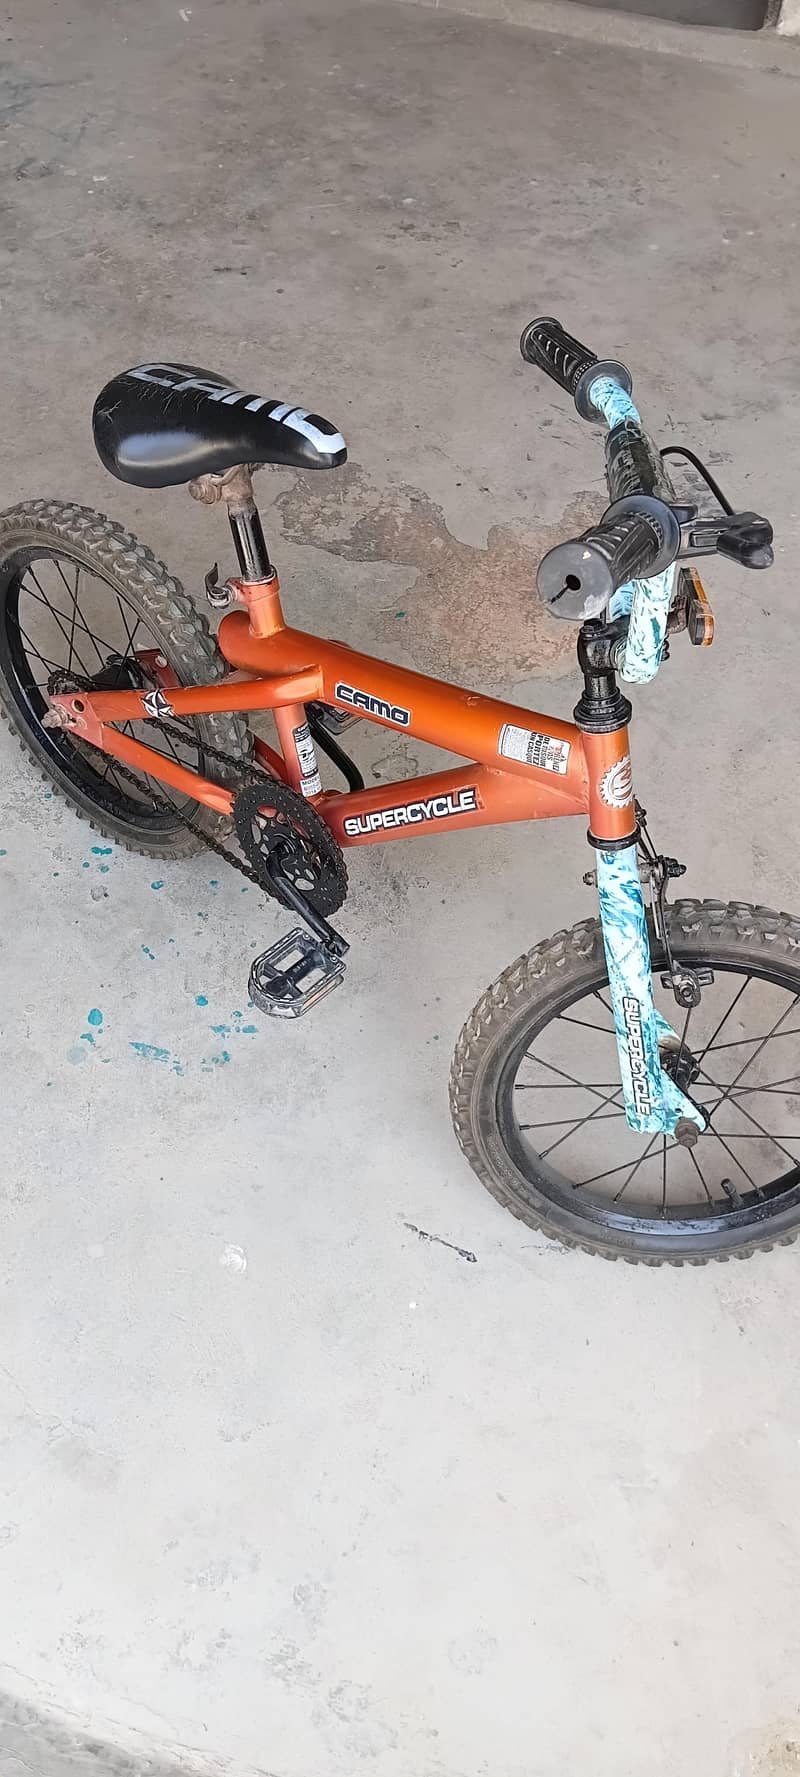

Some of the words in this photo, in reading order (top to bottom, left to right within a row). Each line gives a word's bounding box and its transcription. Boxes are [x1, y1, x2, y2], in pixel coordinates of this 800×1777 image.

[126, 364, 347, 454] CAMO
[336, 684, 409, 725] CAMO
[533, 734, 543, 766] PORTEZ
[344, 790, 476, 836] SUPERCYCLE
[623, 996, 652, 1116] SUPERCYCLE
